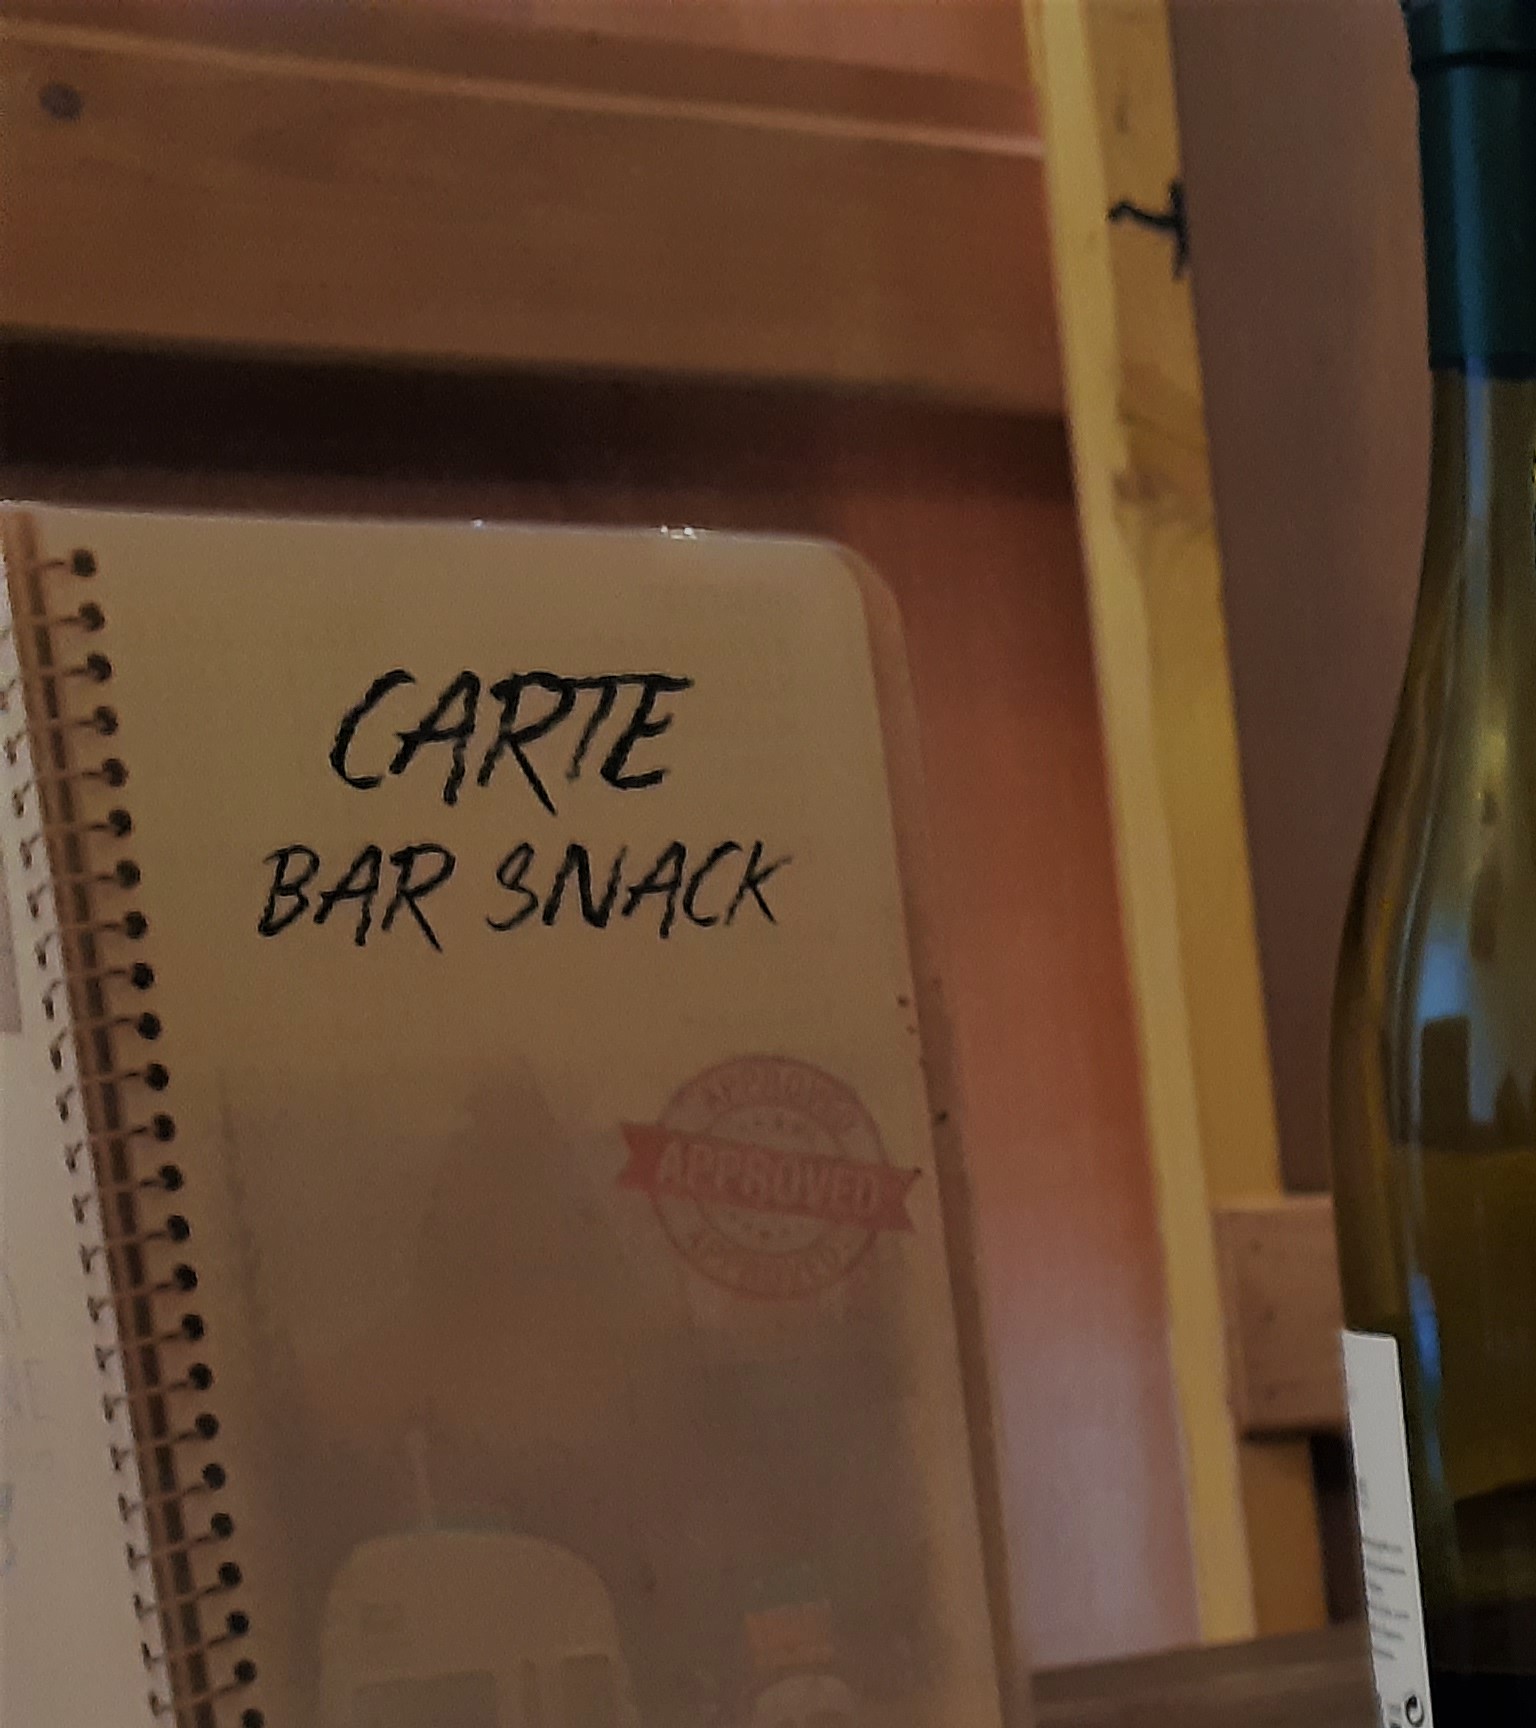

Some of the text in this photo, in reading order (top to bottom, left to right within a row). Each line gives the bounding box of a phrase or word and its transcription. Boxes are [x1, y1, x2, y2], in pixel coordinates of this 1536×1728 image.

[330, 669, 694, 815] CARTE
[257, 839, 794, 951] BAR SNACK
